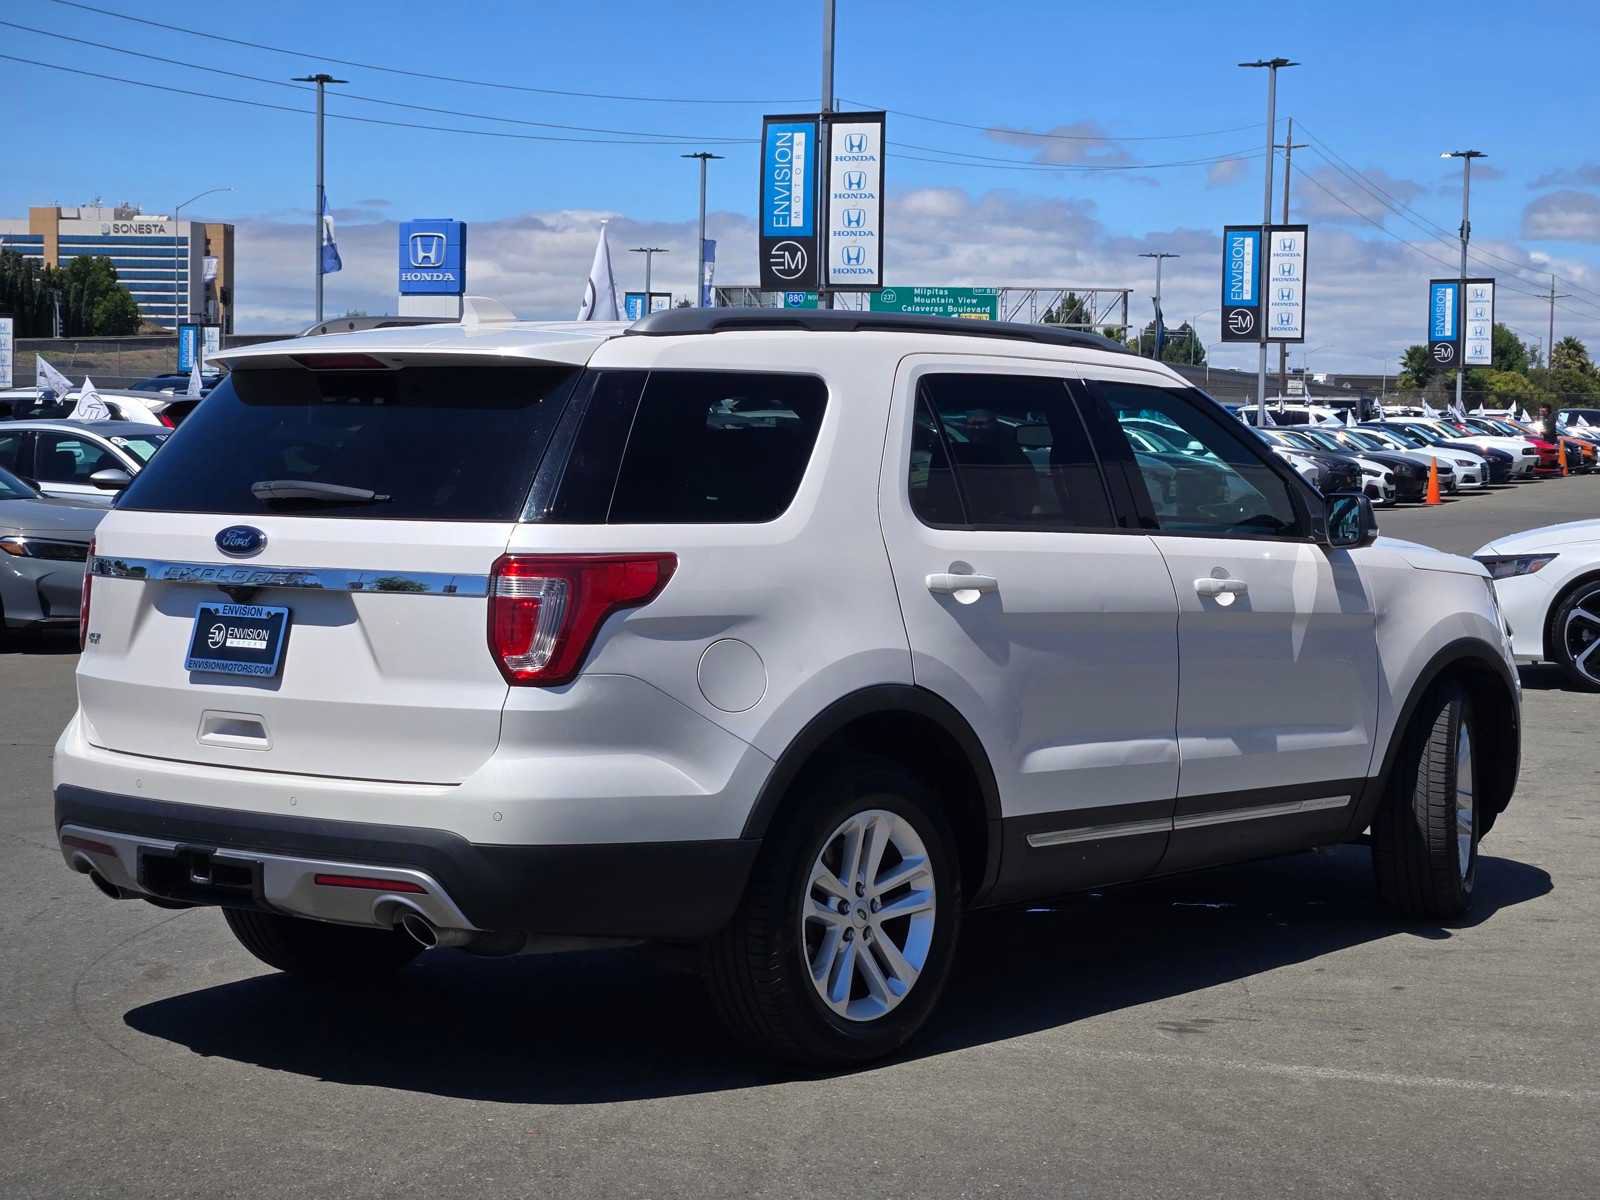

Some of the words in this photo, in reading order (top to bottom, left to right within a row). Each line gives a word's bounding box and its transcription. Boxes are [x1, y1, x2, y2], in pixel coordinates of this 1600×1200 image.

[773, 132, 792, 228] ENVISION
[112, 224, 167, 234] SONESTA
[1232, 237, 1244, 300] ENVISION
[401, 272, 456, 281] HONDA
[788, 294, 804, 302] 880
[914, 288, 948, 296] Milpitas
[948, 305, 990, 313] Boulevard
[1436, 288, 1446, 336] ENVISION
[222, 530, 252, 547] Ford
[165, 567, 305, 584] EXPLORER
[222, 604, 263, 616] ENVISION
[227, 627, 270, 640] ENVISION
[188, 660, 272, 675] ENVISIONMOTORS.COM
